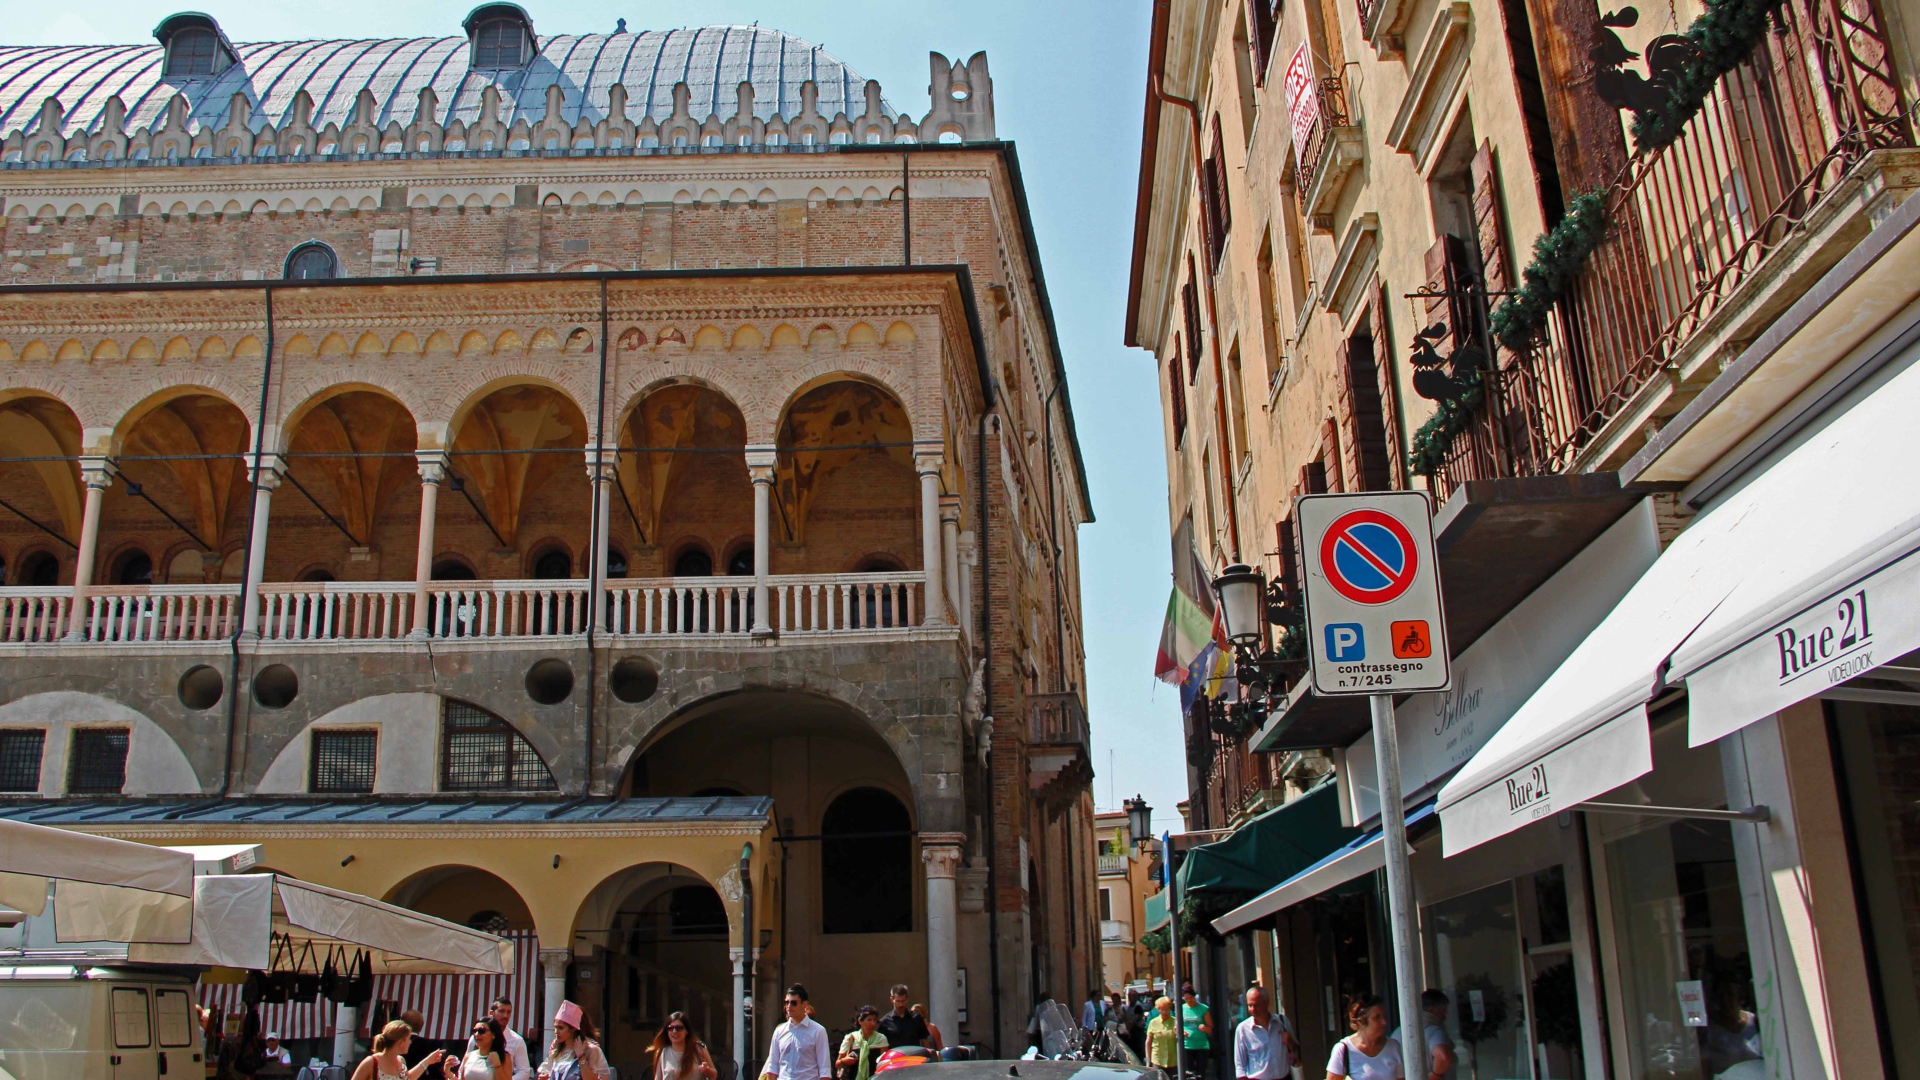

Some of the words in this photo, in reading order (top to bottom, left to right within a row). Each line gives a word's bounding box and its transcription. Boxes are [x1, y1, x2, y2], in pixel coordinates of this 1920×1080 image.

[1333, 628, 1357, 658] P
[1775, 627, 1834, 679] Rue
[1838, 589, 1873, 650] 21
[1337, 663, 1423, 673] contrassegno
[1828, 661, 1852, 684] VIDEO
[1852, 651, 1874, 674] LOOK
[1505, 778, 1534, 811] Rue
[1531, 763, 1550, 799] 21
